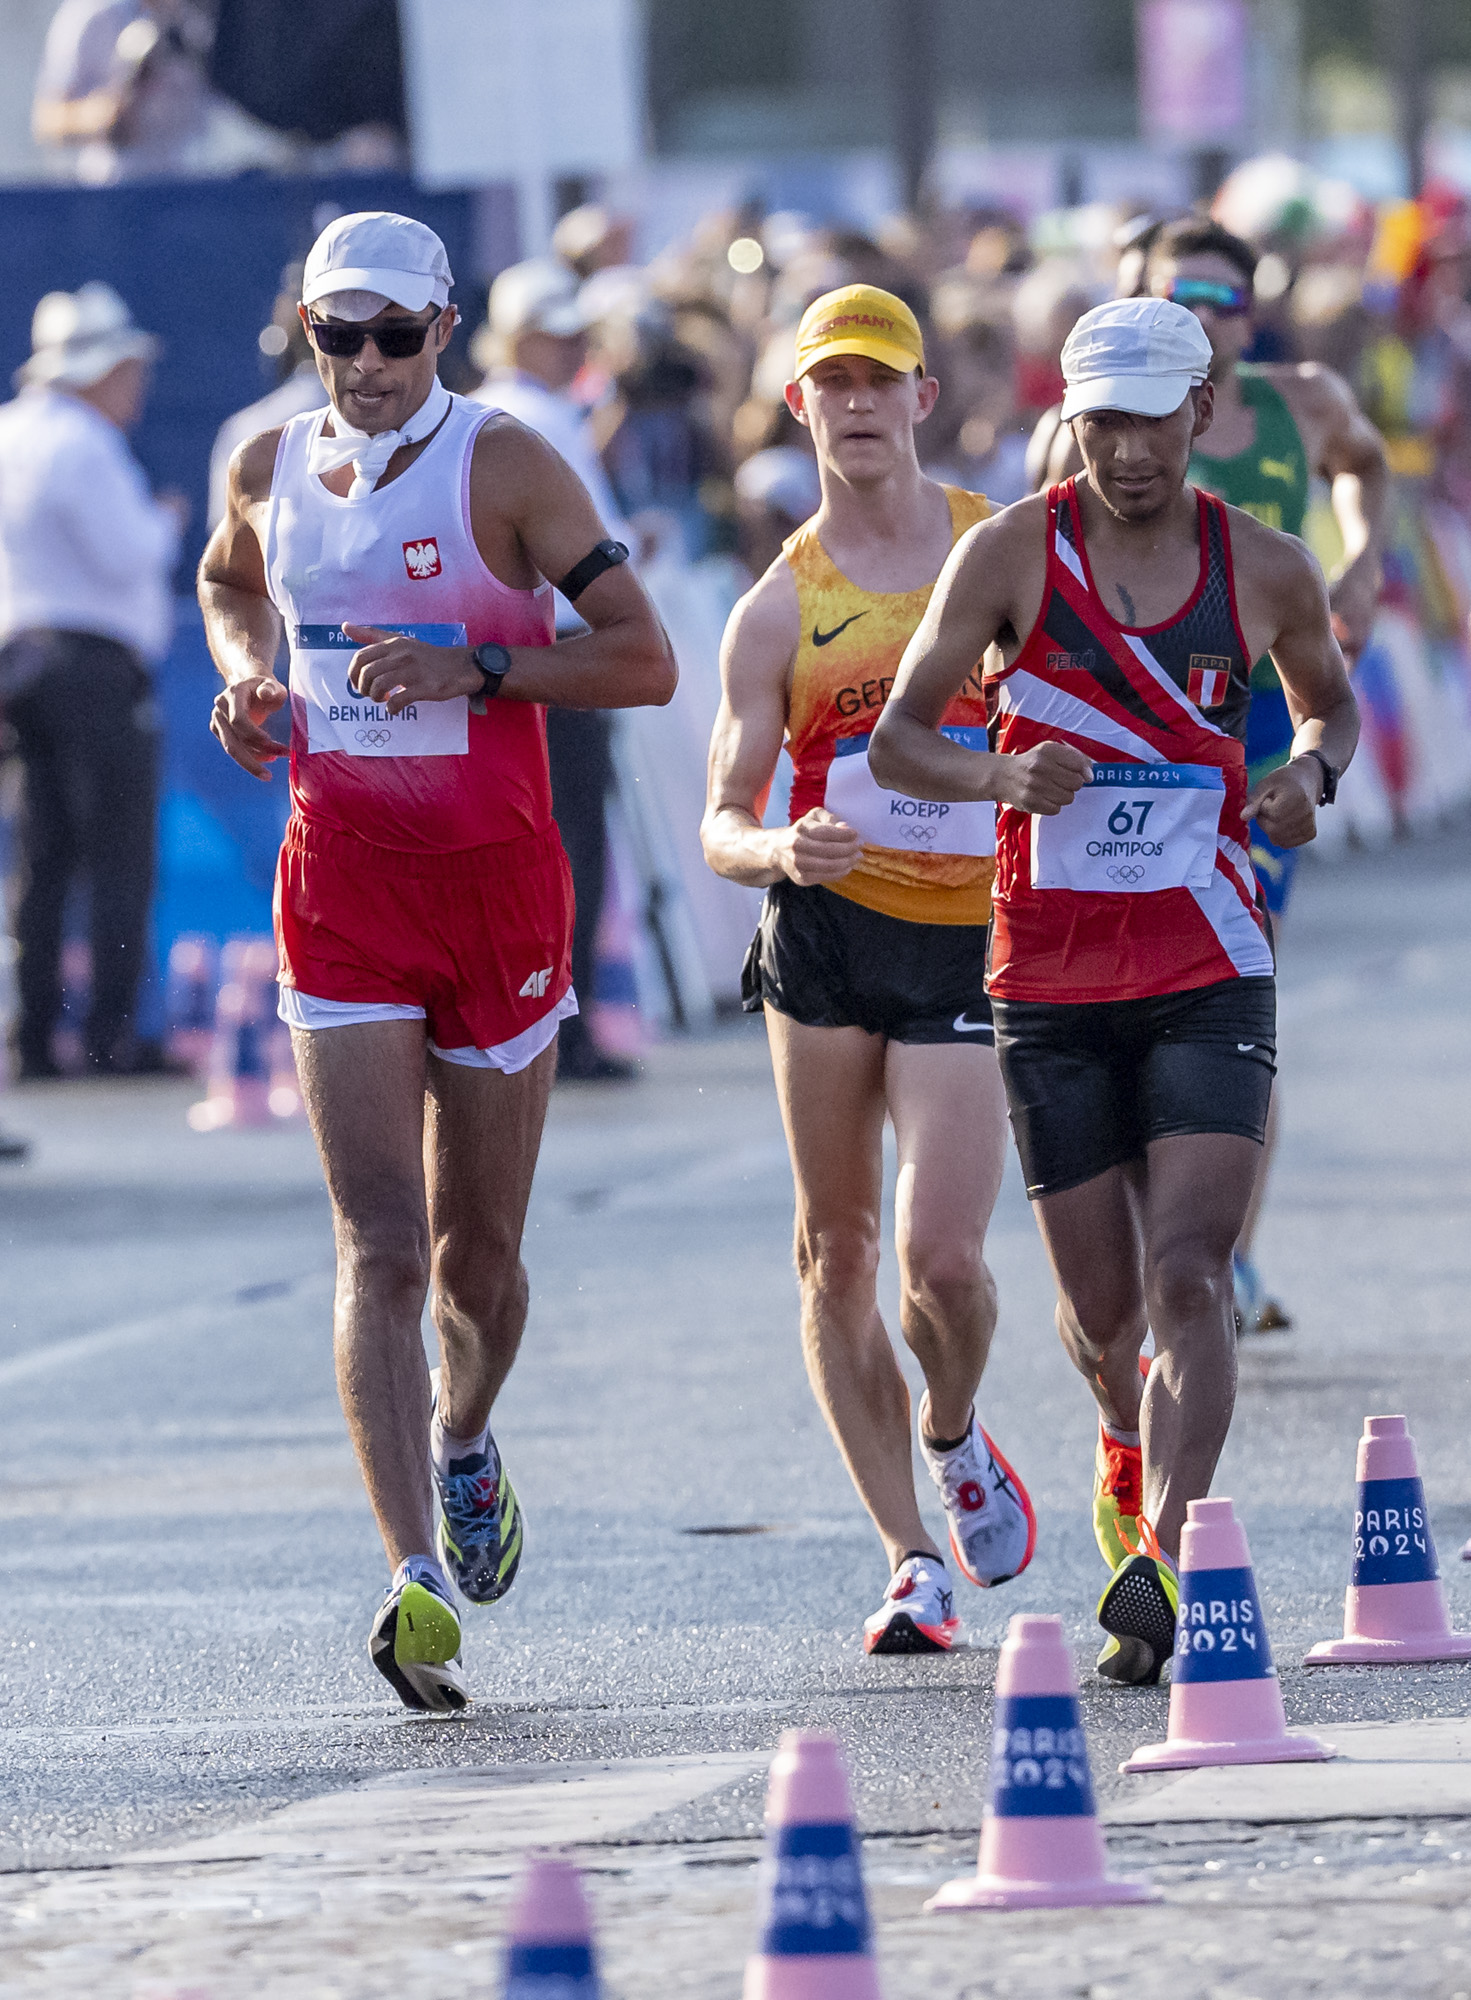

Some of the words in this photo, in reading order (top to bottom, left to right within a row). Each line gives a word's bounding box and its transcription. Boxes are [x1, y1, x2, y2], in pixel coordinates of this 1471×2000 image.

[329, 705, 360, 721] BEN
[1095, 769, 1133, 781] ARIS
[1138, 770, 1180, 782] 2024
[890, 799, 950, 819] KOEPP
[1107, 800, 1155, 836] 67
[1086, 841, 1164, 857] CAMPOS
[518, 965, 554, 999] 4F
[1354, 1533, 1426, 1558] 2024
[1178, 1627, 1256, 1656] 2024
